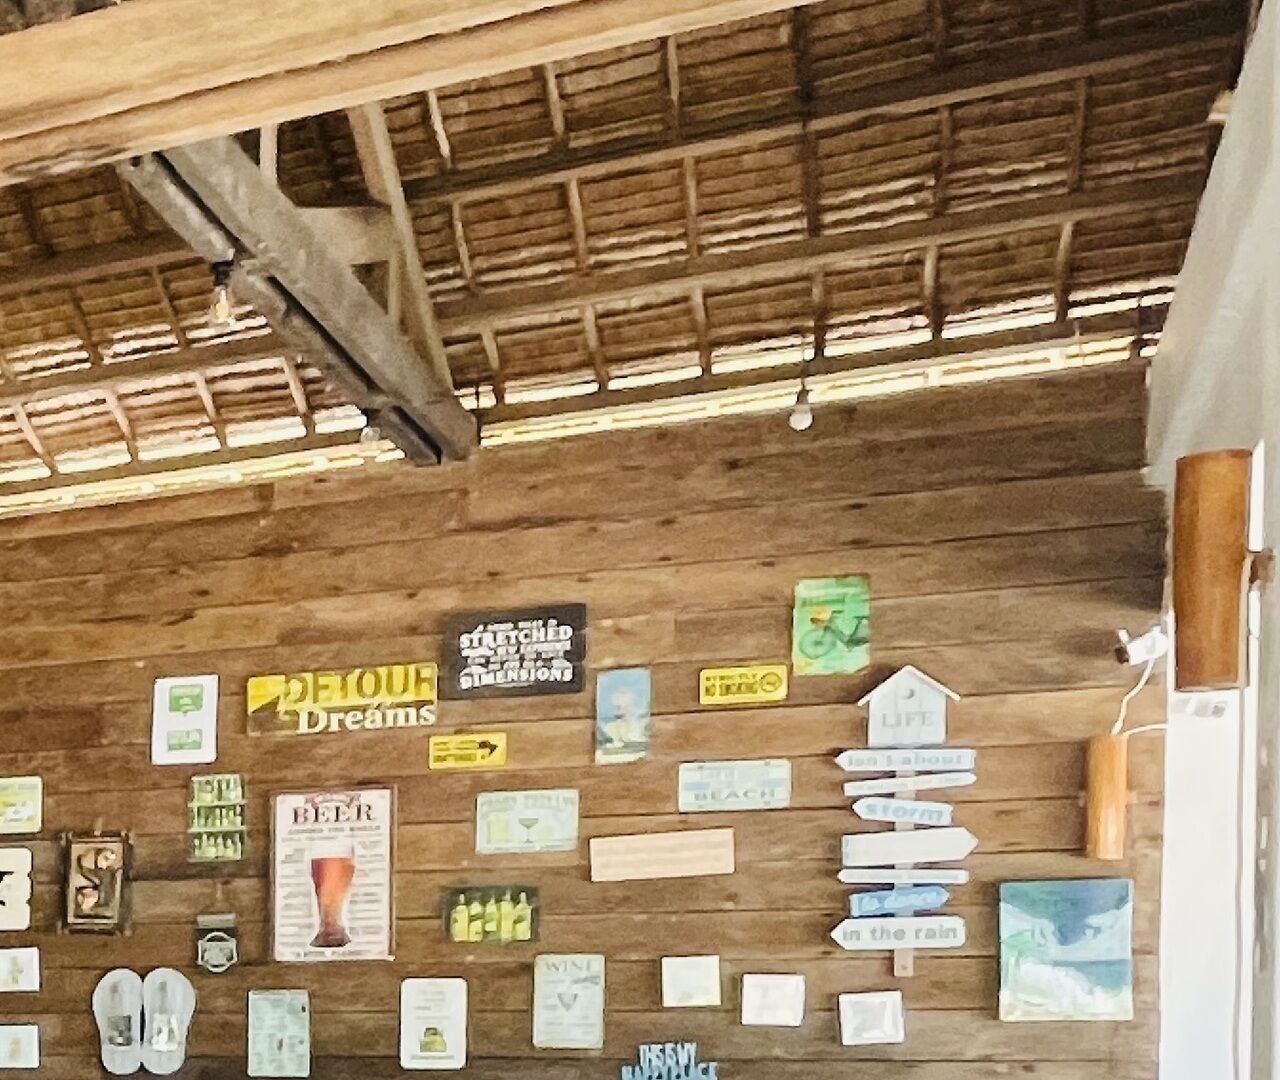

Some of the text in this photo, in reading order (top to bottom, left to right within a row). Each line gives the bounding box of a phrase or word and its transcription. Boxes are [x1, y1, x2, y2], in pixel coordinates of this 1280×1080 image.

[459, 625, 573, 649] STRETCHED
[459, 667, 573, 690] DIMENSIONS
[295, 704, 437, 735] Dreams
[881, 710, 936, 728] LIFE
[900, 751, 963, 766] about
[694, 789, 776, 802] BEACH
[292, 803, 377, 825] BEER
[865, 803, 944, 821] storm
[842, 924, 958, 941] in the rain
